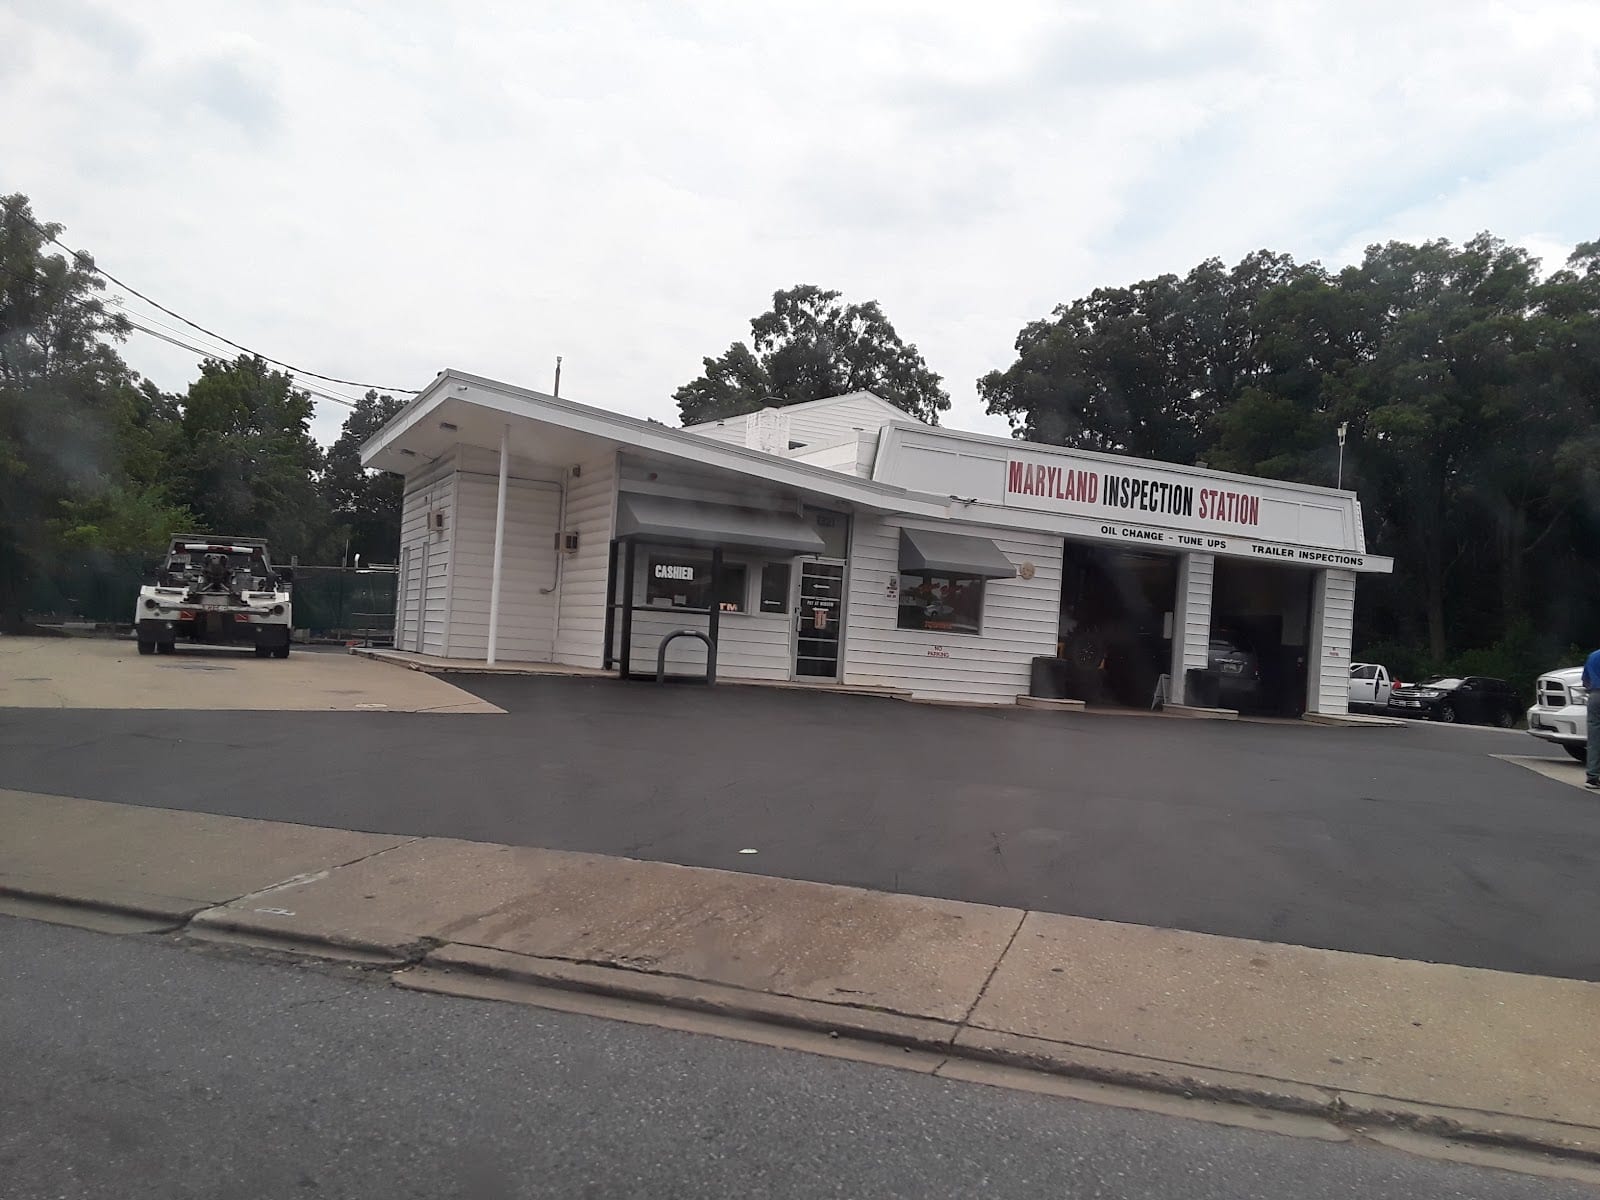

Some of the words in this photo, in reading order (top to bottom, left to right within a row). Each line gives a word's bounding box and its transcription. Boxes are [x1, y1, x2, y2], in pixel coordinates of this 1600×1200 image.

[1008, 460, 1098, 504] MARYLAND
[1103, 474, 1194, 517] INSPECTION
[1199, 488, 1260, 526] STATION
[1101, 525, 1118, 536] OIL
[1122, 528, 1164, 541] CHANGE
[1178, 535, 1203, 546] TUNE
[1207, 539, 1227, 549] UPS
[1252, 545, 1294, 557] TRAILER
[1298, 551, 1364, 566] INSPECTIONS
[655, 564, 694, 581] CASHIER
[718, 602, 738, 612] TM
